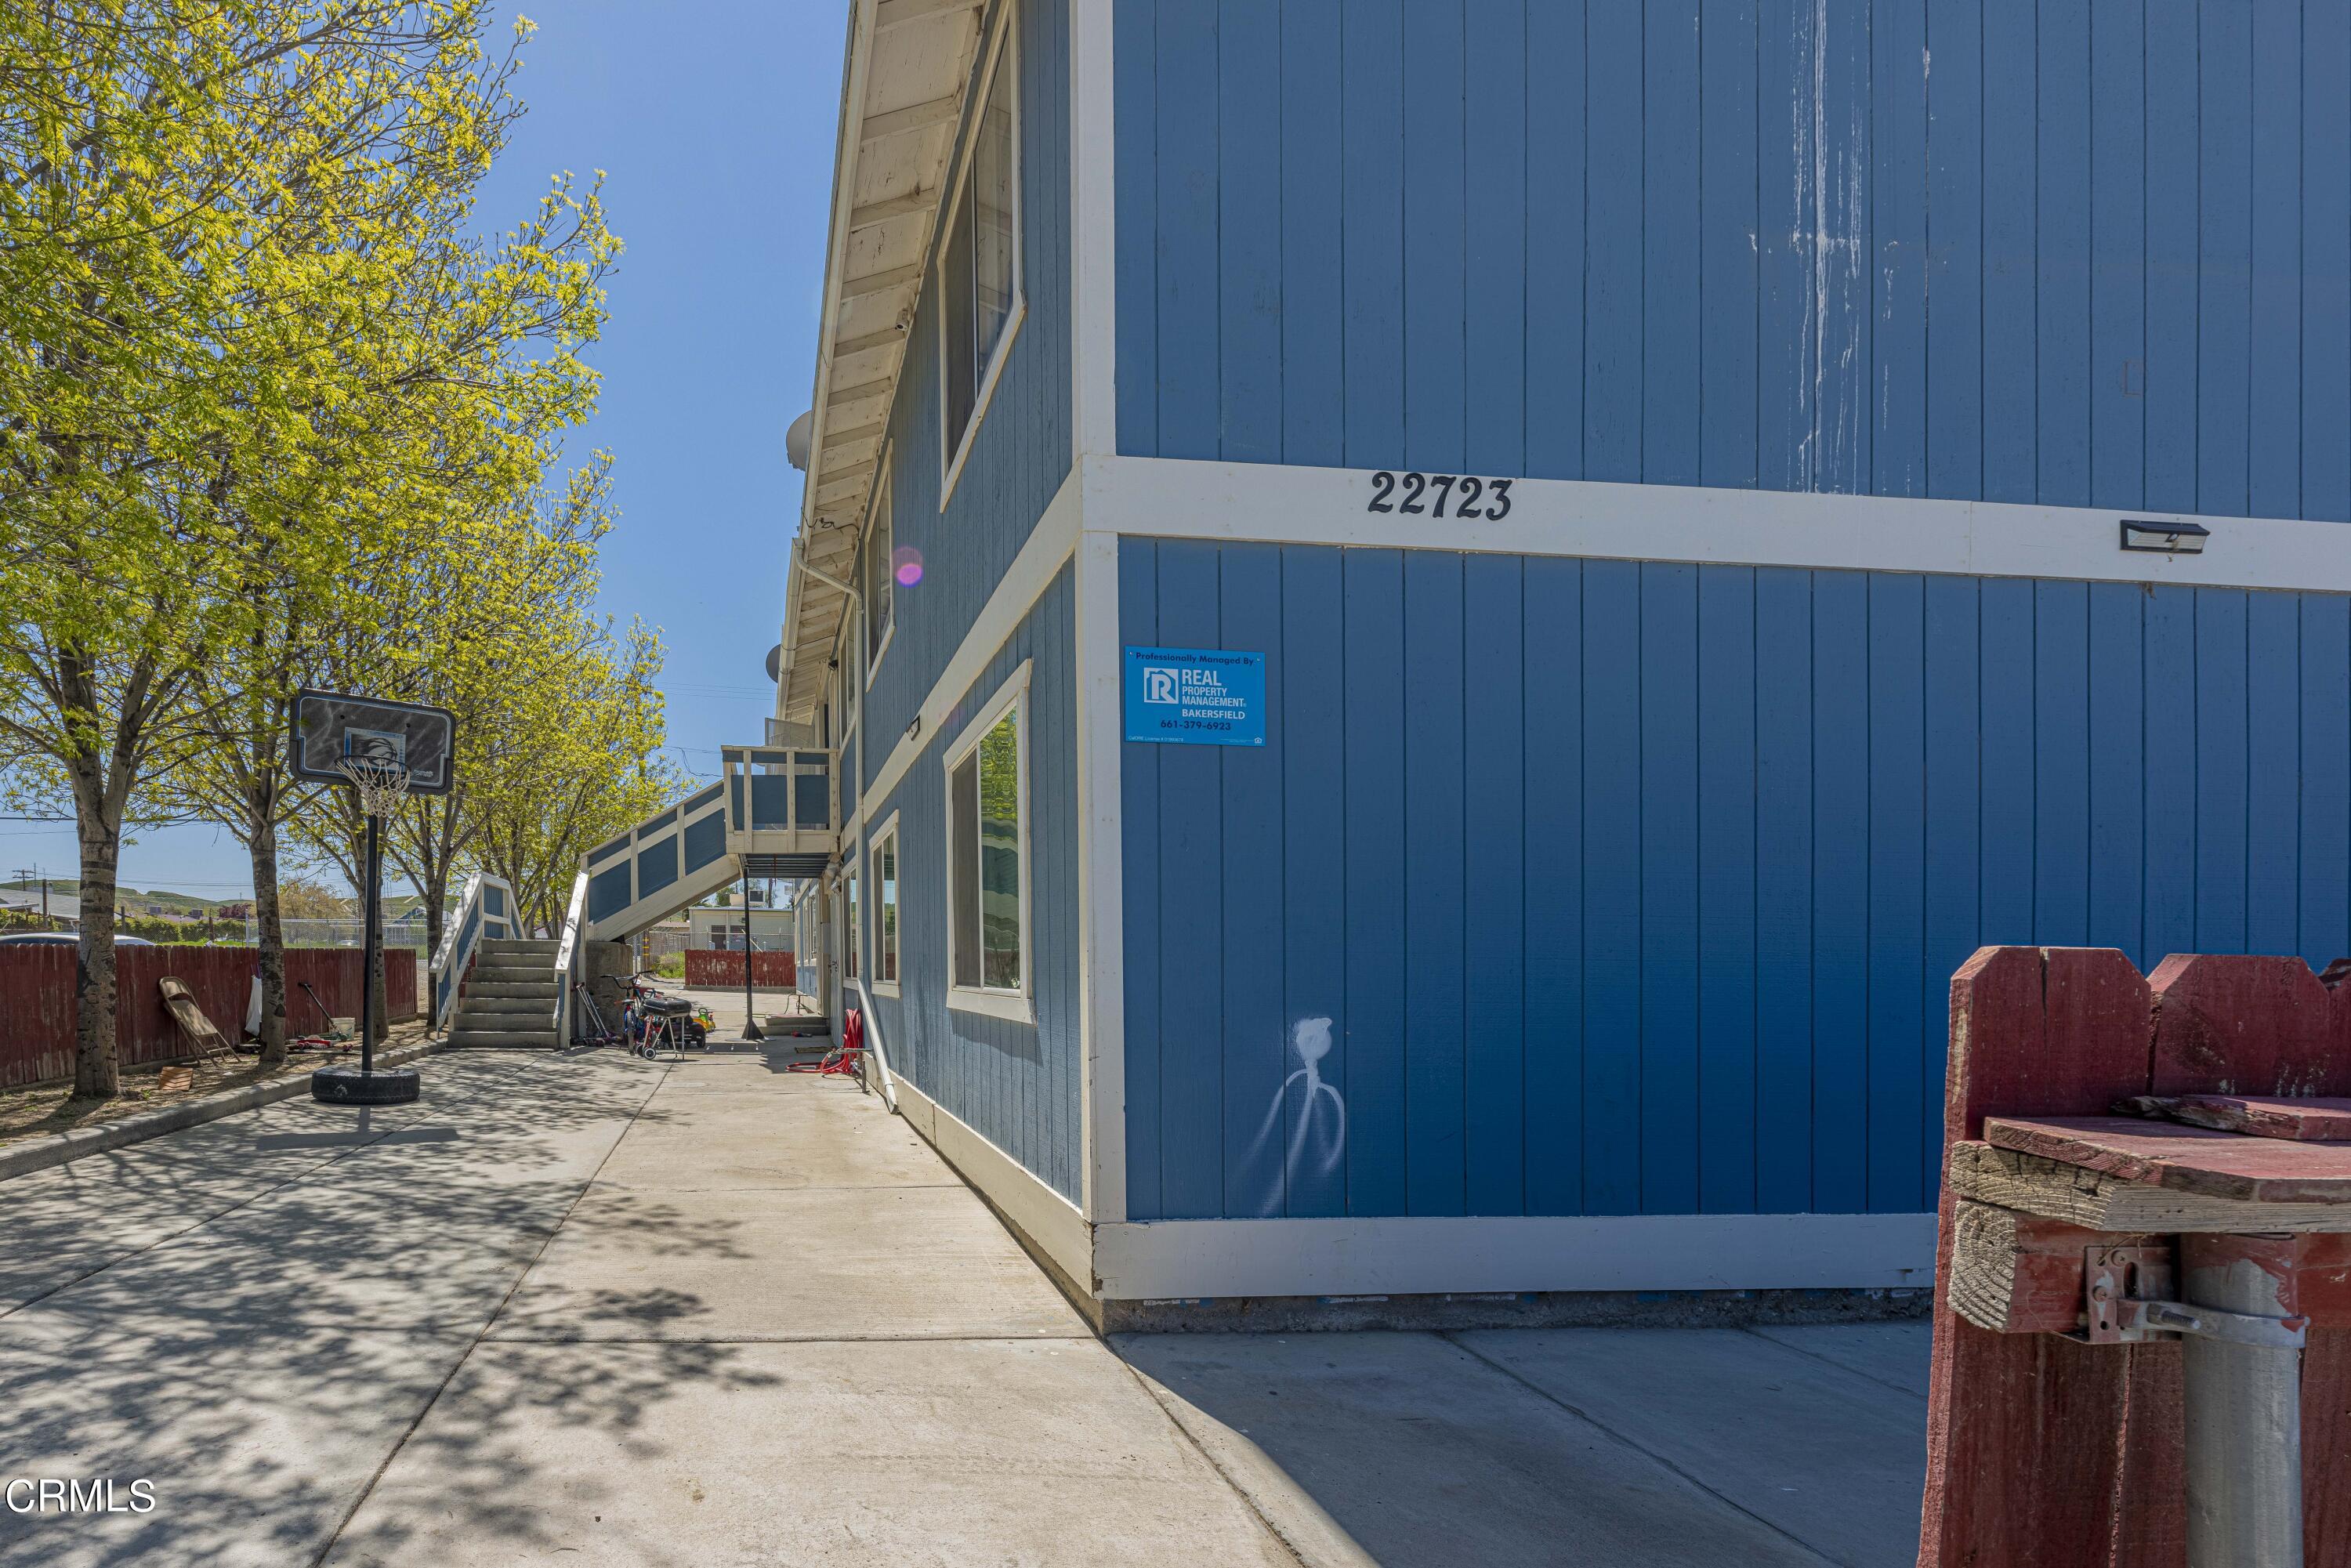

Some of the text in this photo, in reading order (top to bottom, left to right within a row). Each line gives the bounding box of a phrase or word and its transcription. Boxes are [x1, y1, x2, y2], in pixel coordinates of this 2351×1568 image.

[1367, 471, 1513, 521] 22723
[1136, 651, 1254, 666] Professionally Managed By
[1182, 669, 1222, 686] REAL
[1182, 686, 1227, 697] PROPERTY
[1182, 696, 1244, 707] MANAGEMENT
[1182, 709, 1245, 719] BAKERSFIELD
[1160, 720, 1231, 730] 661-379-6923
